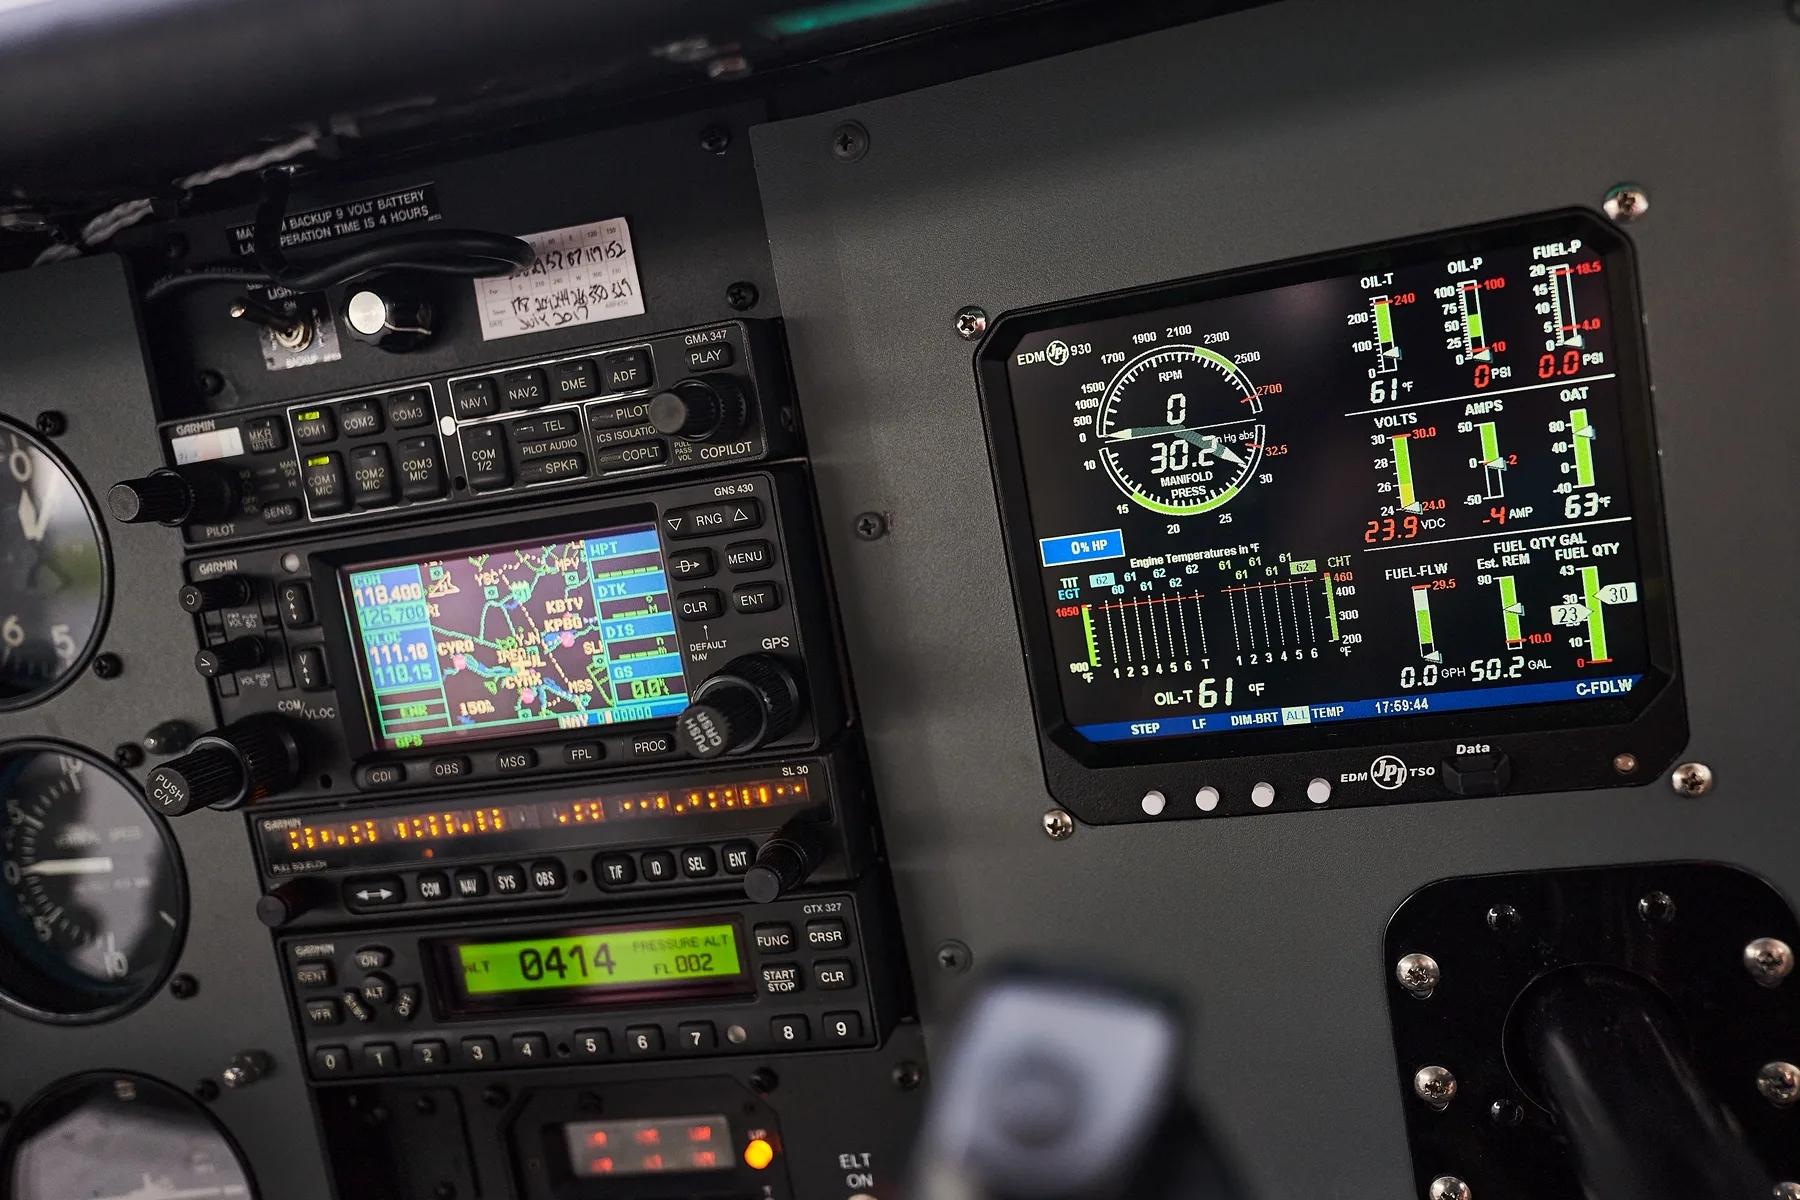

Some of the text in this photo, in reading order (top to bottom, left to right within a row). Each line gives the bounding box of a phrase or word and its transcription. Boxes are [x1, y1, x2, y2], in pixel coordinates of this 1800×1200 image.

[290, 189, 425, 230] BACKUP 9 VOLT BATTERY
[279, 227, 332, 246] PERATION
[335, 221, 361, 236] TIME
[364, 217, 375, 229] IS
[379, 215, 387, 225] 4
[391, 205, 429, 223] HOURS
[1533, 239, 1582, 260] FUEL-P
[1447, 256, 1483, 275] OIL-P
[1575, 260, 1601, 275] 18.5
[1360, 272, 1394, 289] OIL-T
[1484, 277, 1506, 290] 100
[1394, 292, 1416, 306] 240
[1434, 286, 1455, 299] 100
[553, 305, 589, 325] 2017
[1347, 312, 1368, 325] 200
[684, 330, 727, 345] GMA 347
[1132, 331, 1157, 344] 1900
[1166, 324, 1192, 338] 2100
[1203, 331, 1230, 344] 2300
[1352, 341, 1372, 353] 100
[691, 349, 722, 365] PLAY
[1017, 351, 1045, 366] EDM
[1070, 343, 1092, 357] 930
[1101, 352, 1126, 365] 1700
[1234, 351, 1261, 365] 2500
[1538, 350, 1604, 379] 0.0 PSI
[613, 369, 637, 383] ADF
[1158, 370, 1183, 382] RPM
[1473, 364, 1511, 388] 0 PSI
[561, 377, 586, 391] DME
[1081, 381, 1105, 394] 1500
[1370, 377, 1398, 404] 61
[509, 386, 538, 400] NAV2
[1560, 387, 1589, 402] OAT
[1075, 397, 1099, 410] 1000
[1465, 400, 1503, 416] AMPS
[393, 407, 423, 420] COM3
[1374, 412, 1417, 429] VOLTS
[344, 416, 375, 430] COM2
[542, 420, 565, 432] TEL
[1073, 415, 1092, 427] 500
[248, 428, 272, 441] MKR
[1412, 427, 1437, 439] 30.0
[523, 438, 578, 455] PILOT AUDIO
[700, 441, 752, 460] COPILOT
[1265, 444, 1288, 457] 32.5
[472, 448, 496, 461] COM
[622, 446, 659, 462] COPLT
[1150, 435, 1217, 475] 30.2
[403, 458, 433, 471] COM3
[545, 459, 578, 474] SPKR
[356, 467, 385, 480] COM2
[410, 470, 428, 481] MIC
[1160, 470, 1213, 487] MANIFOLD
[362, 479, 380, 490] MIC
[714, 484, 754, 497] GNS 430
[1171, 485, 1206, 499] PRESS
[1565, 492, 1599, 519] 63
[696, 513, 723, 527] RNG
[1482, 507, 1533, 525] -4 AMP
[206, 523, 235, 538] PILOT
[1364, 516, 1446, 543] 23.9 VDC
[1071, 539, 1108, 555] 0% HP
[1494, 532, 1587, 554] FUEL QTY GAL
[728, 551, 762, 564] MENU
[1130, 556, 1164, 569] Engine
[1165, 546, 1237, 564] Temperatures
[1238, 544, 1248, 556] in
[1555, 542, 1620, 561] FUEL QTY
[1327, 555, 1351, 568] CHT
[1385, 563, 1448, 580] FUEL-FLW
[1060, 577, 1078, 589] TIT
[1432, 579, 1456, 591] 29.5
[354, 583, 422, 608] 118.400
[1058, 588, 1080, 600] EGT
[1336, 586, 1356, 596] 400
[545, 597, 584, 614] KBTV
[741, 593, 765, 606] ENT
[683, 602, 708, 614] CLR
[1056, 607, 1079, 618] 1650
[1339, 610, 1359, 620] 300
[360, 605, 425, 627] 126.700
[2, 616, 25, 646] 6
[52, 624, 76, 657] 5
[690, 640, 727, 651] DEFAULT
[762, 636, 789, 650] GPS
[1342, 634, 1362, 644] 200
[370, 642, 429, 666] 111.10
[375, 663, 432, 686] 110.15
[1070, 662, 1089, 673] 900
[1470, 656, 1551, 682] 50.2 GAL
[1400, 664, 1465, 689] 0.0 GPH
[1154, 689, 1194, 706] OIL-T
[1198, 677, 1233, 708] 61
[1576, 679, 1633, 696] C-FDLW
[1375, 698, 1429, 714] 17:59:44
[1231, 712, 1279, 726] DIM-BRT
[1131, 723, 1160, 735] STEP
[634, 740, 666, 753] PROC
[1456, 744, 1490, 755] Data
[571, 749, 592, 760] FPL
[435, 763, 459, 775] OBS
[501, 756, 526, 768] MSG
[372, 772, 391, 783] CDI
[1340, 772, 1368, 782] EDM
[1409, 767, 1435, 776] TSO
[154, 788, 173, 806] C/V
[688, 857, 706, 871] SEL
[498, 875, 516, 890] SYS
[536, 871, 555, 886] OBS
[421, 882, 441, 897] COM
[460, 879, 477, 894] NAV
[803, 903, 842, 914] GTX 327
[757, 935, 790, 946] FUNC
[809, 930, 842, 942] CRSR
[632, 934, 728, 953] PRESSURE ALT
[361, 956, 378, 967] ON
[520, 943, 617, 981] 0414
[654, 952, 714, 976] FL 002
[764, 969, 794, 981] START
[820, 972, 844, 982] CLR
[768, 982, 795, 992] STOP
[839, 1152, 871, 1169] ELT
[846, 1173, 873, 1189] ON
